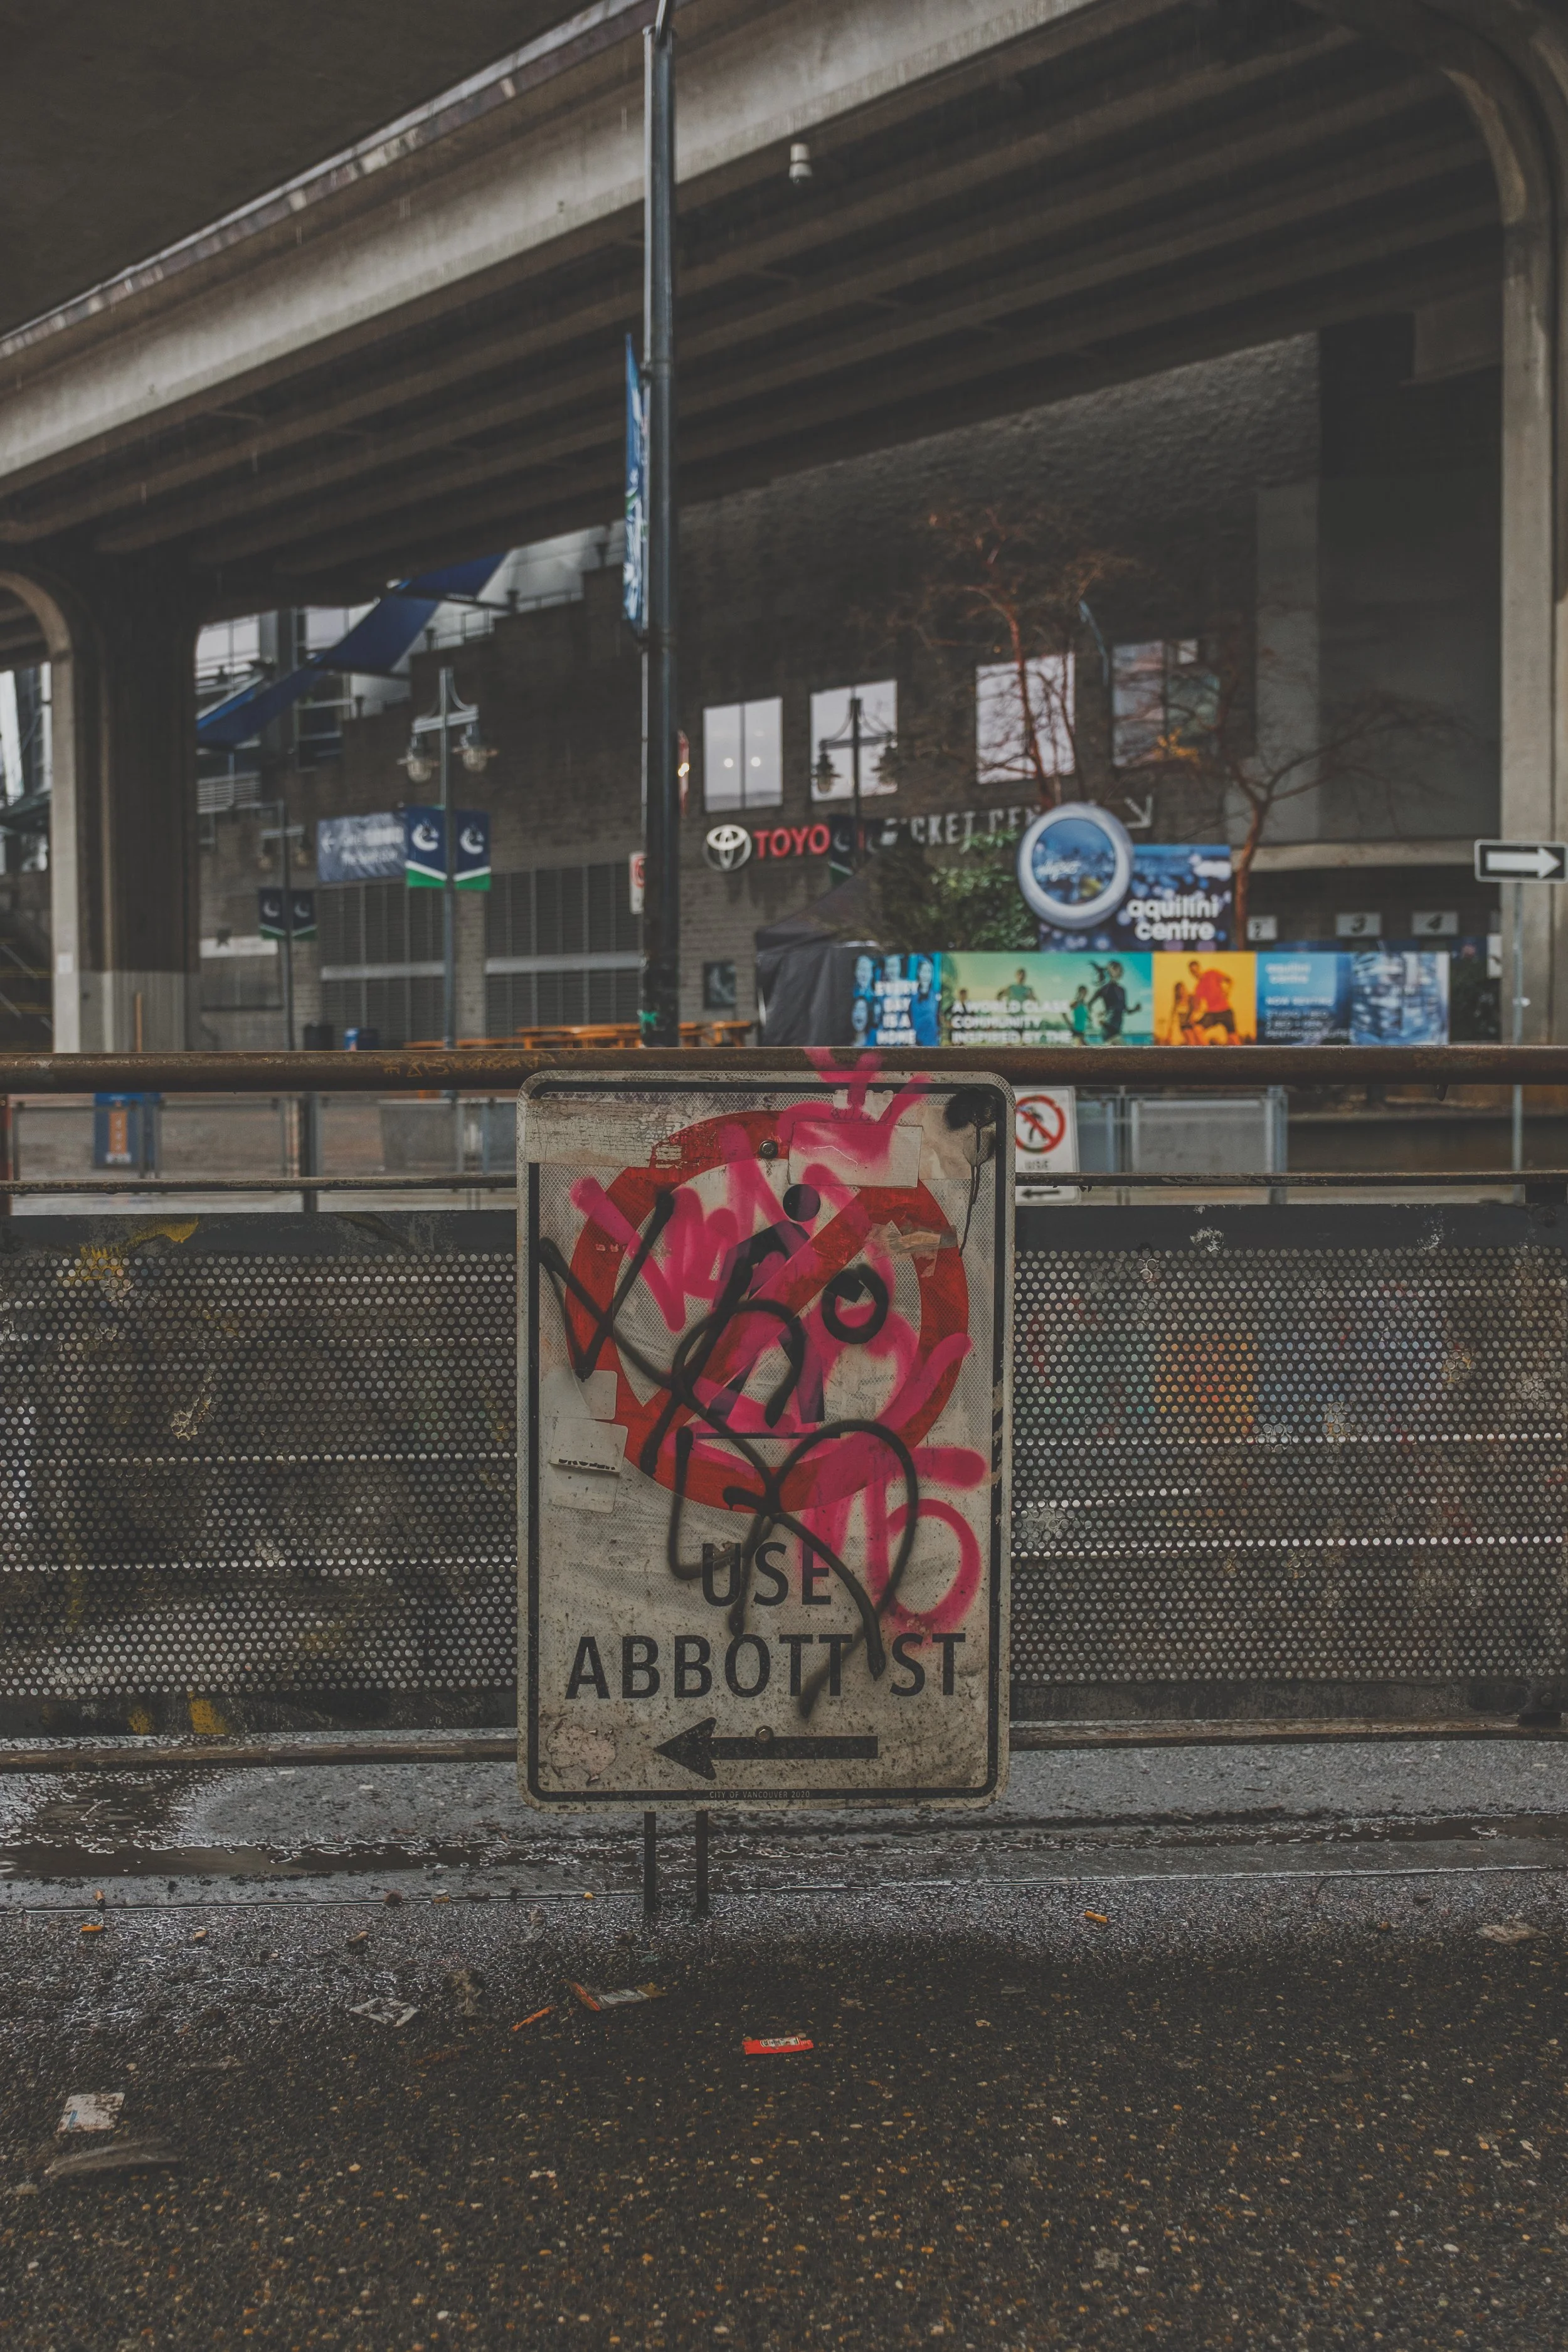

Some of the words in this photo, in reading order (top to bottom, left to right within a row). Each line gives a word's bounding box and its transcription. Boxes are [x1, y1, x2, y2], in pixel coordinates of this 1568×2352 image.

[880, 810, 976, 847] CKET
[753, 822, 864, 859] TOYO
[1126, 893, 1219, 922] aquilini
[1135, 919, 1216, 941] centre
[1350, 914, 1366, 934] 3
[1426, 913, 1443, 931] 4
[951, 1000, 965, 1014] A
[965, 999, 1021, 1014] WORLD
[898, 1013, 911, 1028] A
[951, 1015, 1042, 1029] COMMUNITY
[876, 1029, 916, 1045] HOME
[951, 1030, 1021, 1046] INSPIRED
[1044, 1030, 1073, 1045] THE
[701, 1542, 832, 1608] USE
[564, 1633, 853, 1699] ABBOTT
[889, 1632, 967, 1697] ST
